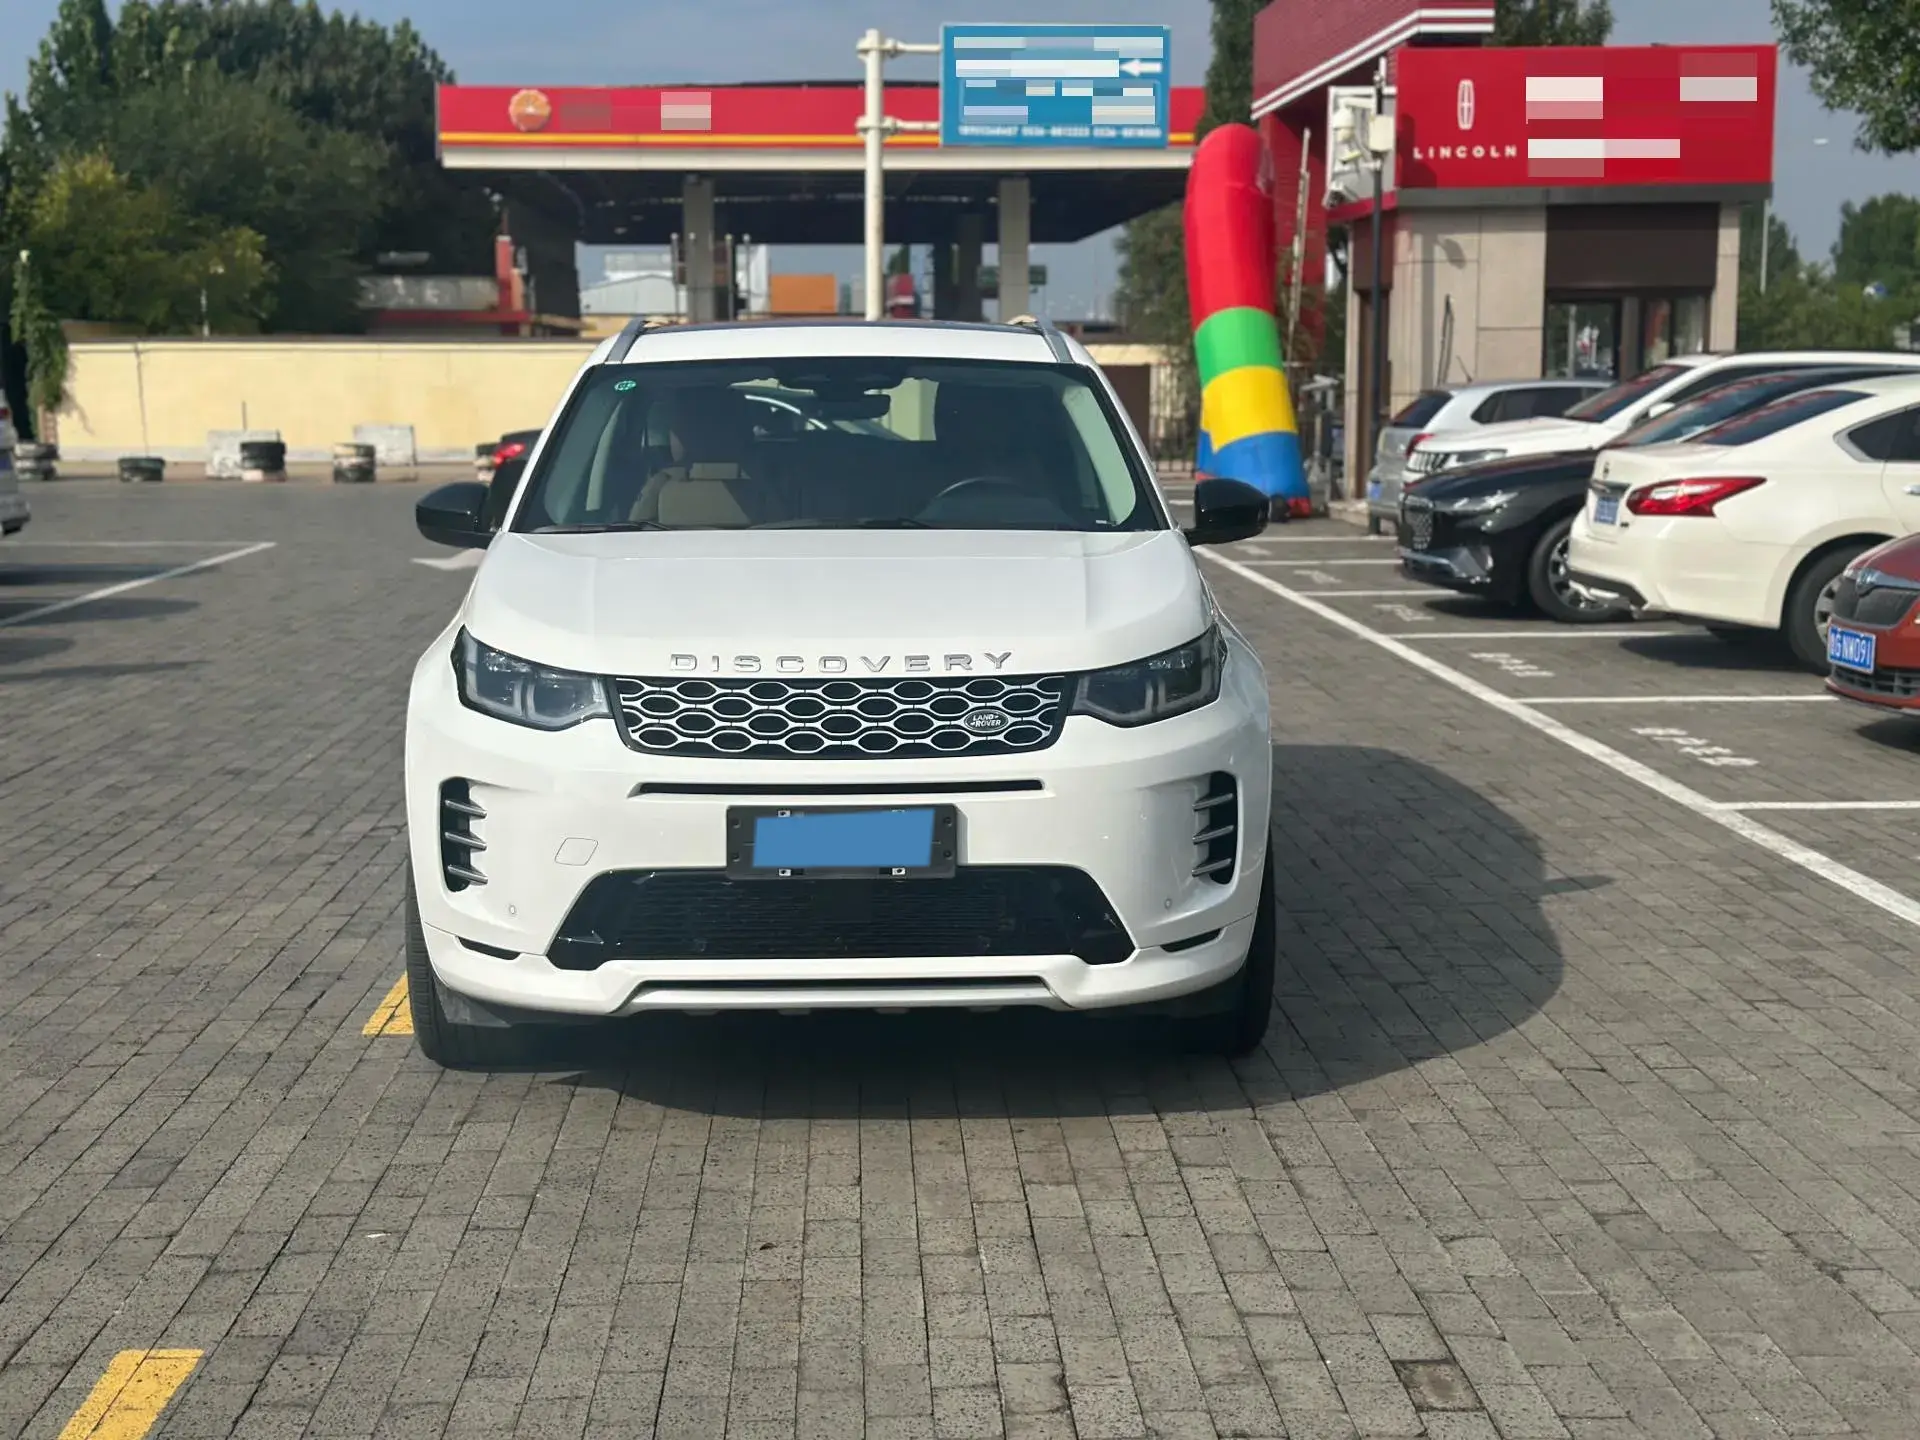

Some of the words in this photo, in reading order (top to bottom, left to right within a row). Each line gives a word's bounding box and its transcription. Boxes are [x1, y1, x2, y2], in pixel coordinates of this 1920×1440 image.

[1413, 144, 1517, 160] LINCOLN
[670, 651, 1012, 673] DISCOVERY
[975, 719, 1001, 727] ROVER
